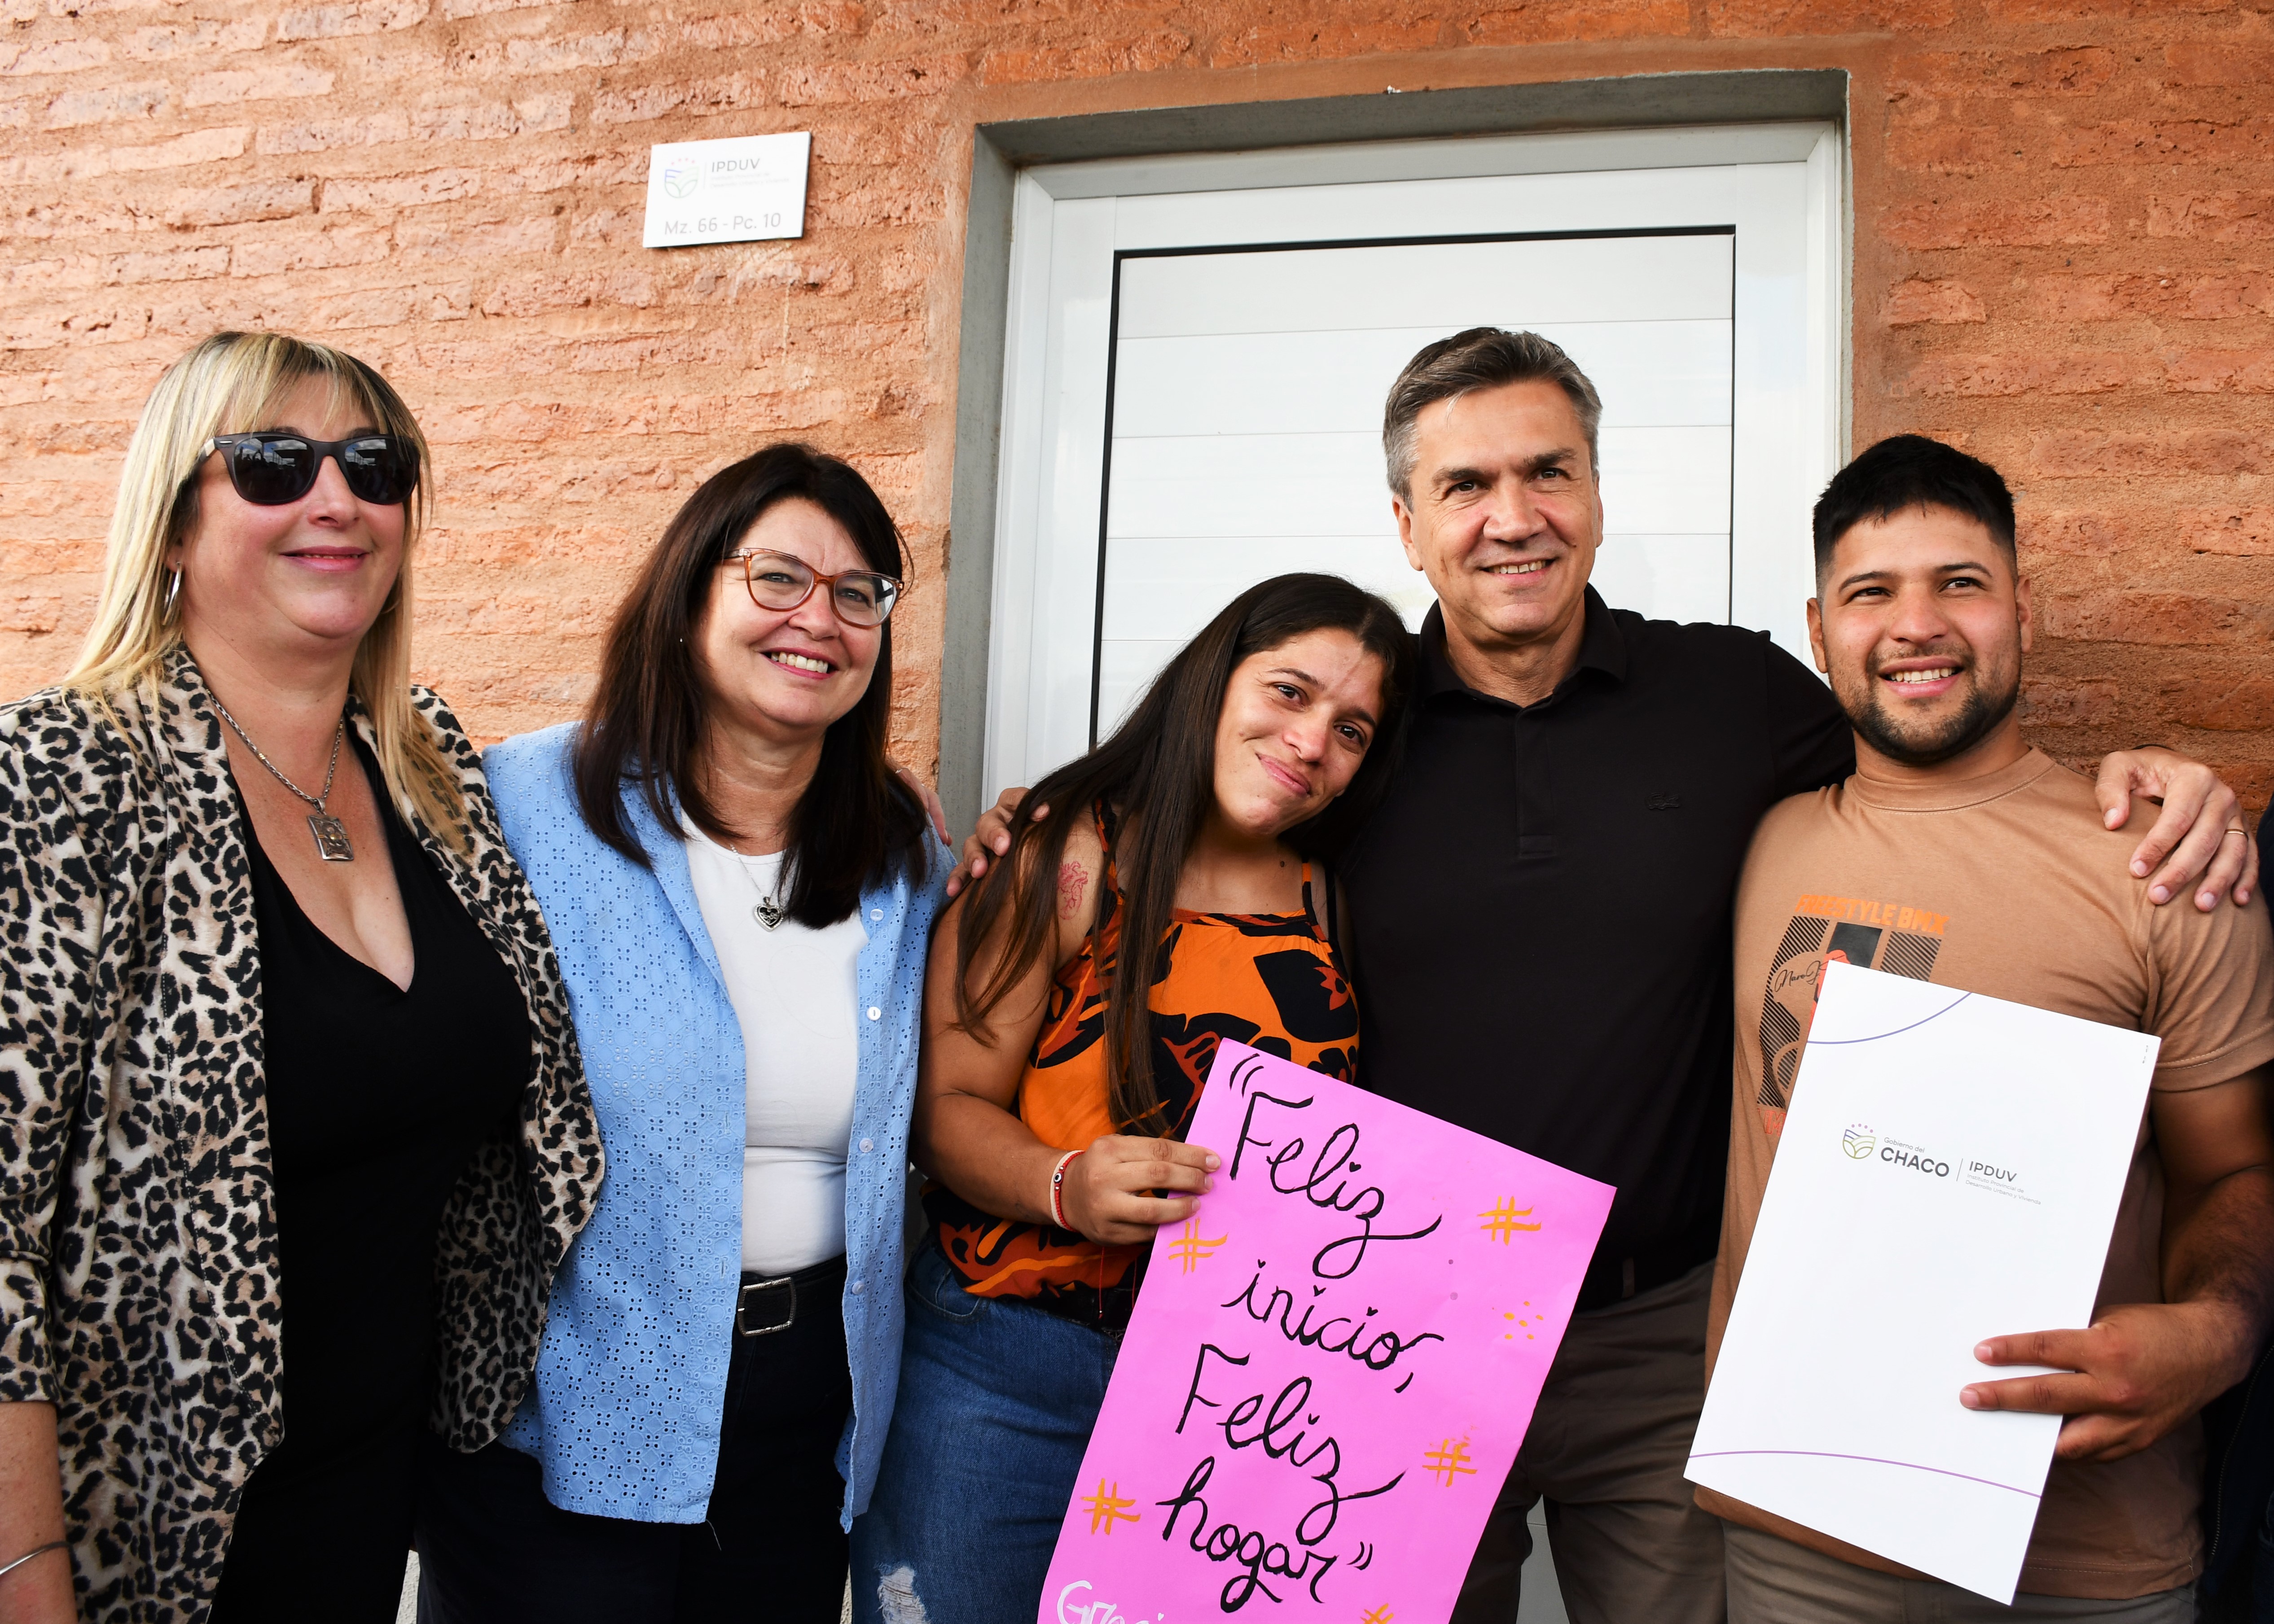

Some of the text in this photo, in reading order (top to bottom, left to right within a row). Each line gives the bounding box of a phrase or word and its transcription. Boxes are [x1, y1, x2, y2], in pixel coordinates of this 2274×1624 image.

[711, 158, 760, 173] IPDUV
[664, 221, 692, 235] Mz.
[698, 217, 718, 232] 66
[733, 216, 757, 230] Pc.
[764, 213, 781, 228] 10
[1795, 894, 1950, 935] FREESTYLE BMX
[1883, 1137, 1914, 1151] Gobierno
[1880, 1147, 1950, 1178] CHACO
[1969, 1160, 2018, 1182] IPDUV
[1965, 1180, 1992, 1191] Desarrollo
[1993, 1188, 2013, 1197] Urbano
[2018, 1195, 2041, 1205] Vivienda
[1967, 1173, 1989, 1183] Instituto
[1990, 1180, 2016, 1191] Provincial
[1220, 1258, 1445, 1393] inicio,
[1175, 1343, 1408, 1547] Feliz
